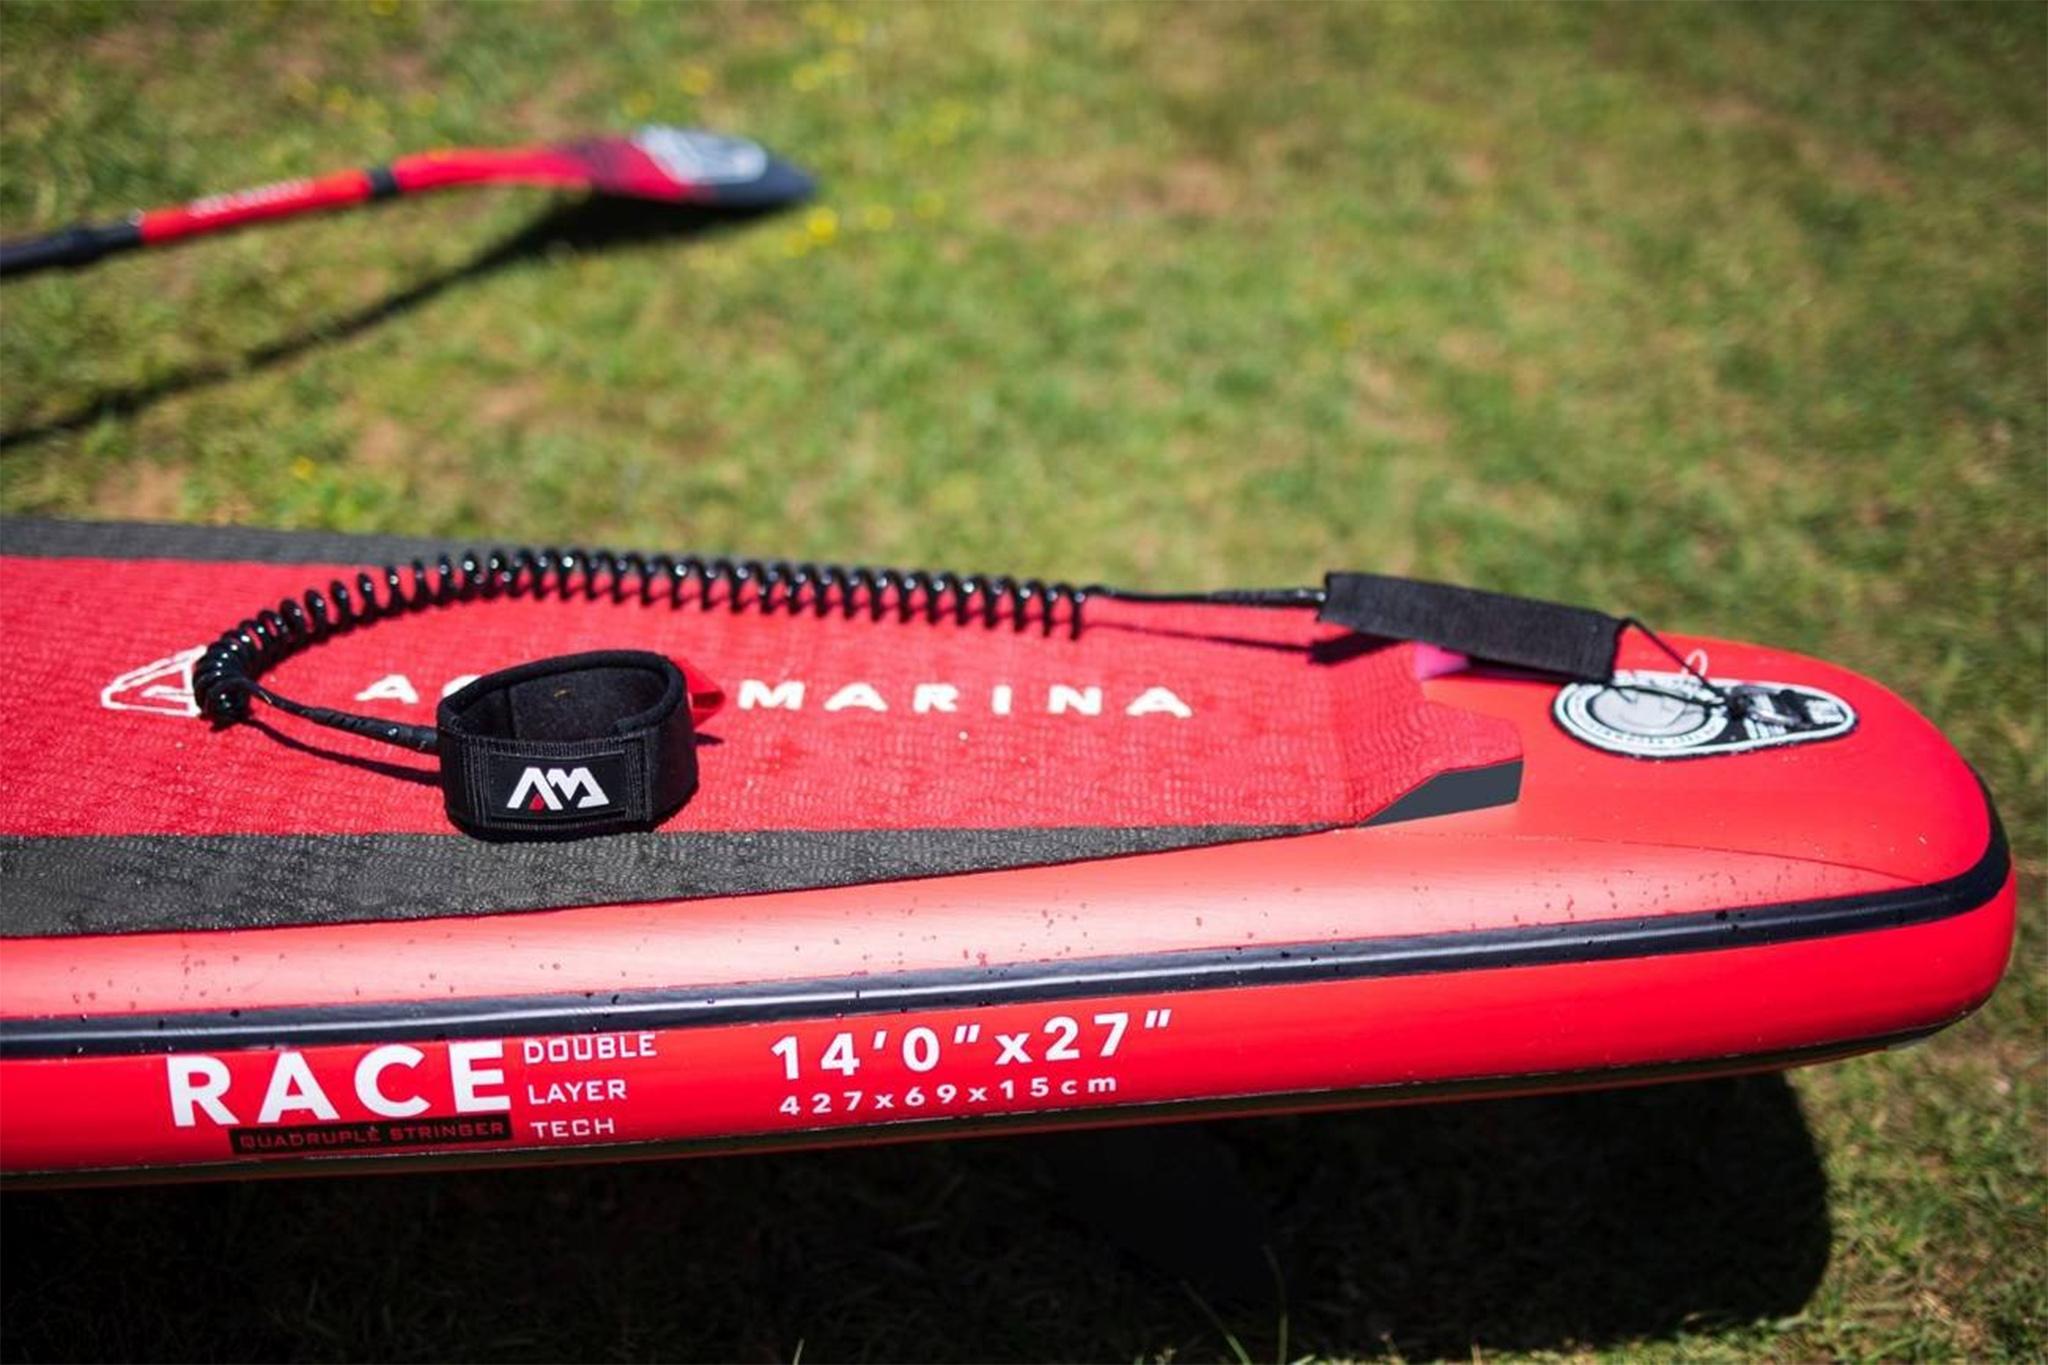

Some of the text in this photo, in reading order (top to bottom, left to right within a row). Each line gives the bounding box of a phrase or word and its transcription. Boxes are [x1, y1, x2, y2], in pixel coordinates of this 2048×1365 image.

[738, 680, 1192, 718] MARINA
[523, 1033, 658, 1065] DOUBLE
[166, 1040, 512, 1127] RACE
[527, 1079, 628, 1106] LAYER
[239, 1120, 505, 1150] QUADRUPLE STRINGER
[529, 1118, 616, 1139] TECH
